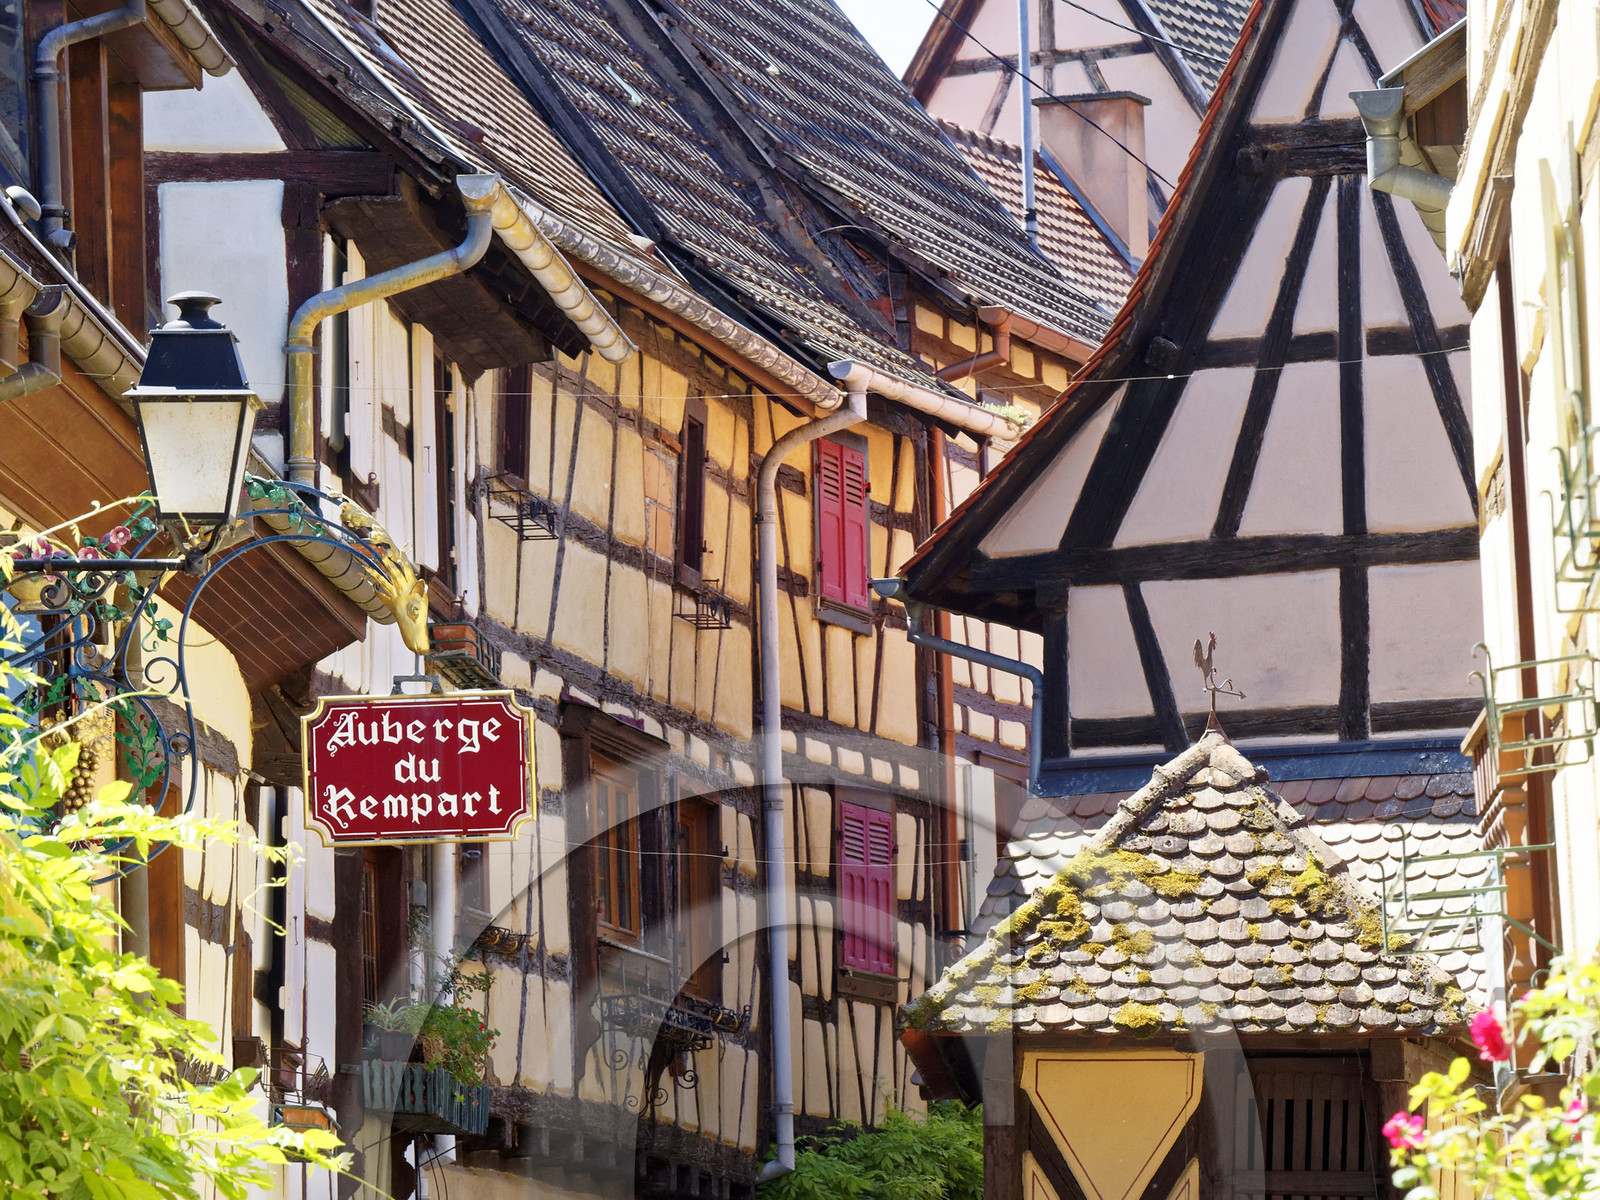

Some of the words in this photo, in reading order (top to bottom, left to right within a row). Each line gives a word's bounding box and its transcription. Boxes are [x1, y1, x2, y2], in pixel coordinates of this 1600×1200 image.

[326, 710, 502, 757] Auberge
[394, 751, 442, 784] du
[322, 783, 503, 829] Rempart
